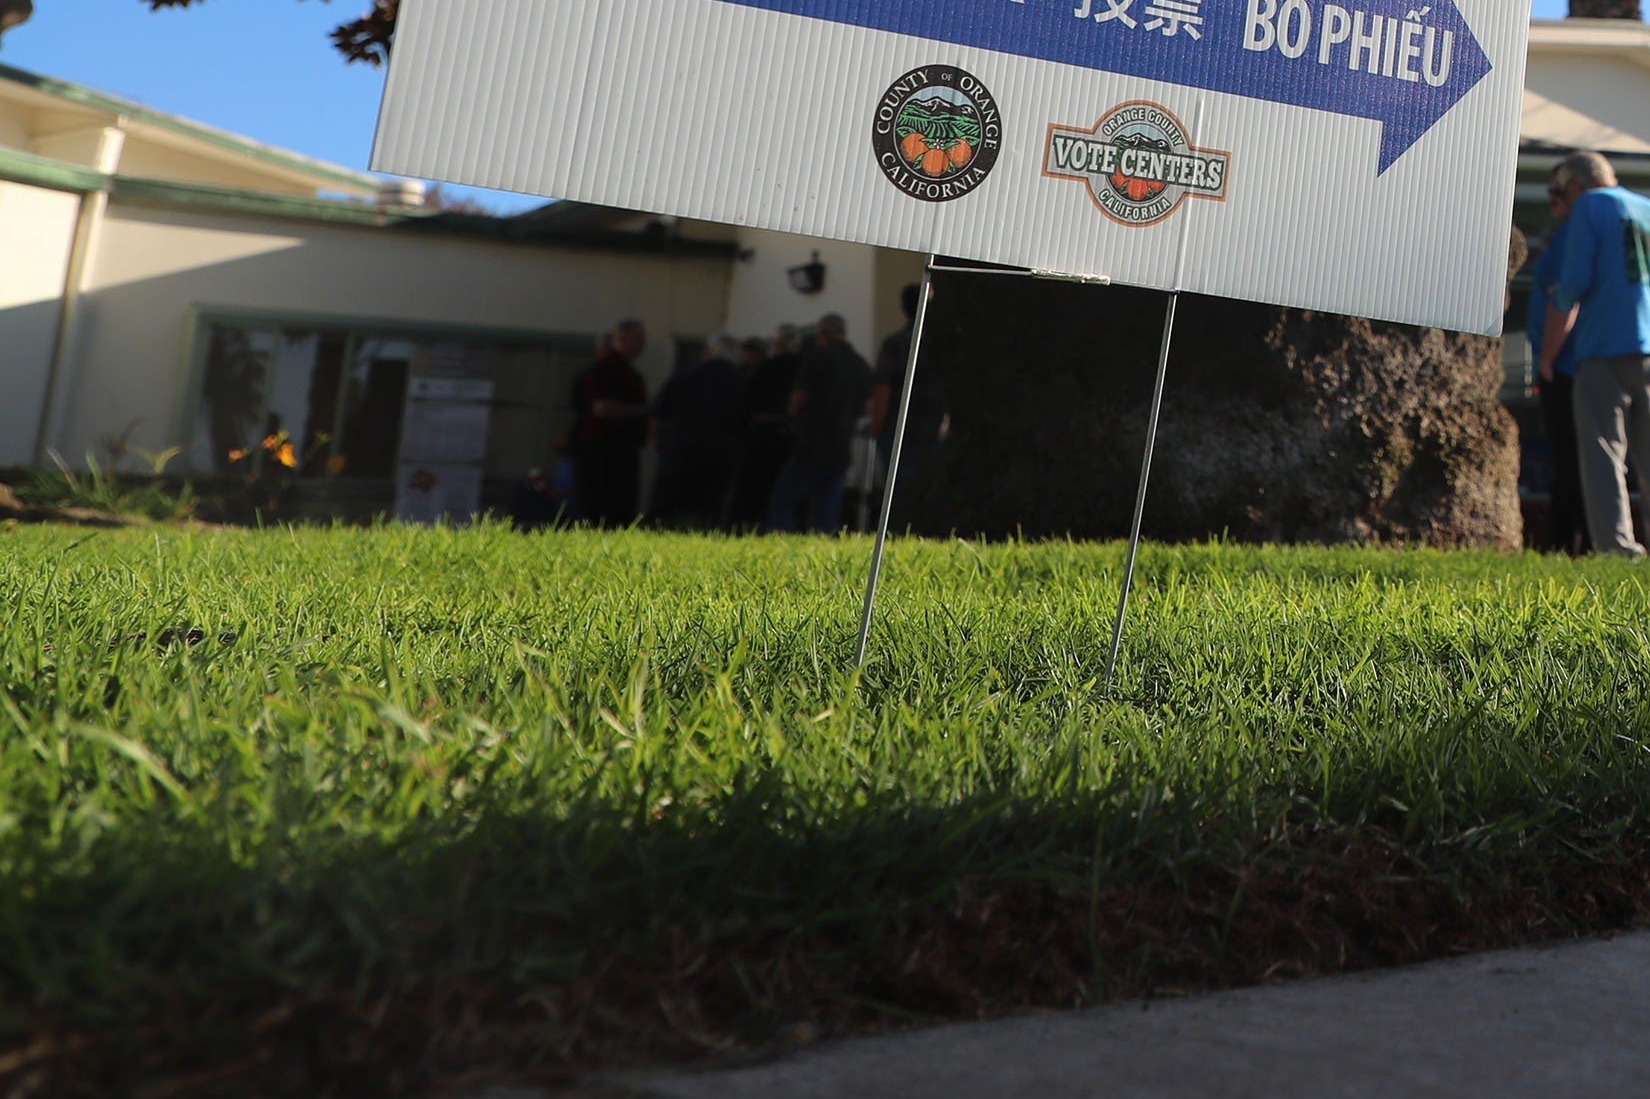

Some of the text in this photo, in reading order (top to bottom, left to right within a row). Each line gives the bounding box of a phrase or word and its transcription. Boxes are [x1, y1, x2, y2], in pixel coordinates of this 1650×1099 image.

[1319, 4, 1453, 86] PHIẾU
[876, 69, 999, 150] COUNTY OF ORANGE
[1103, 108, 1183, 147] ORANGE COUNTY
[881, 151, 986, 199] CALIFORNIA
[1053, 136, 1224, 190] VOTE CENTERS
[1099, 188, 1170, 221] CALIFORNIA
